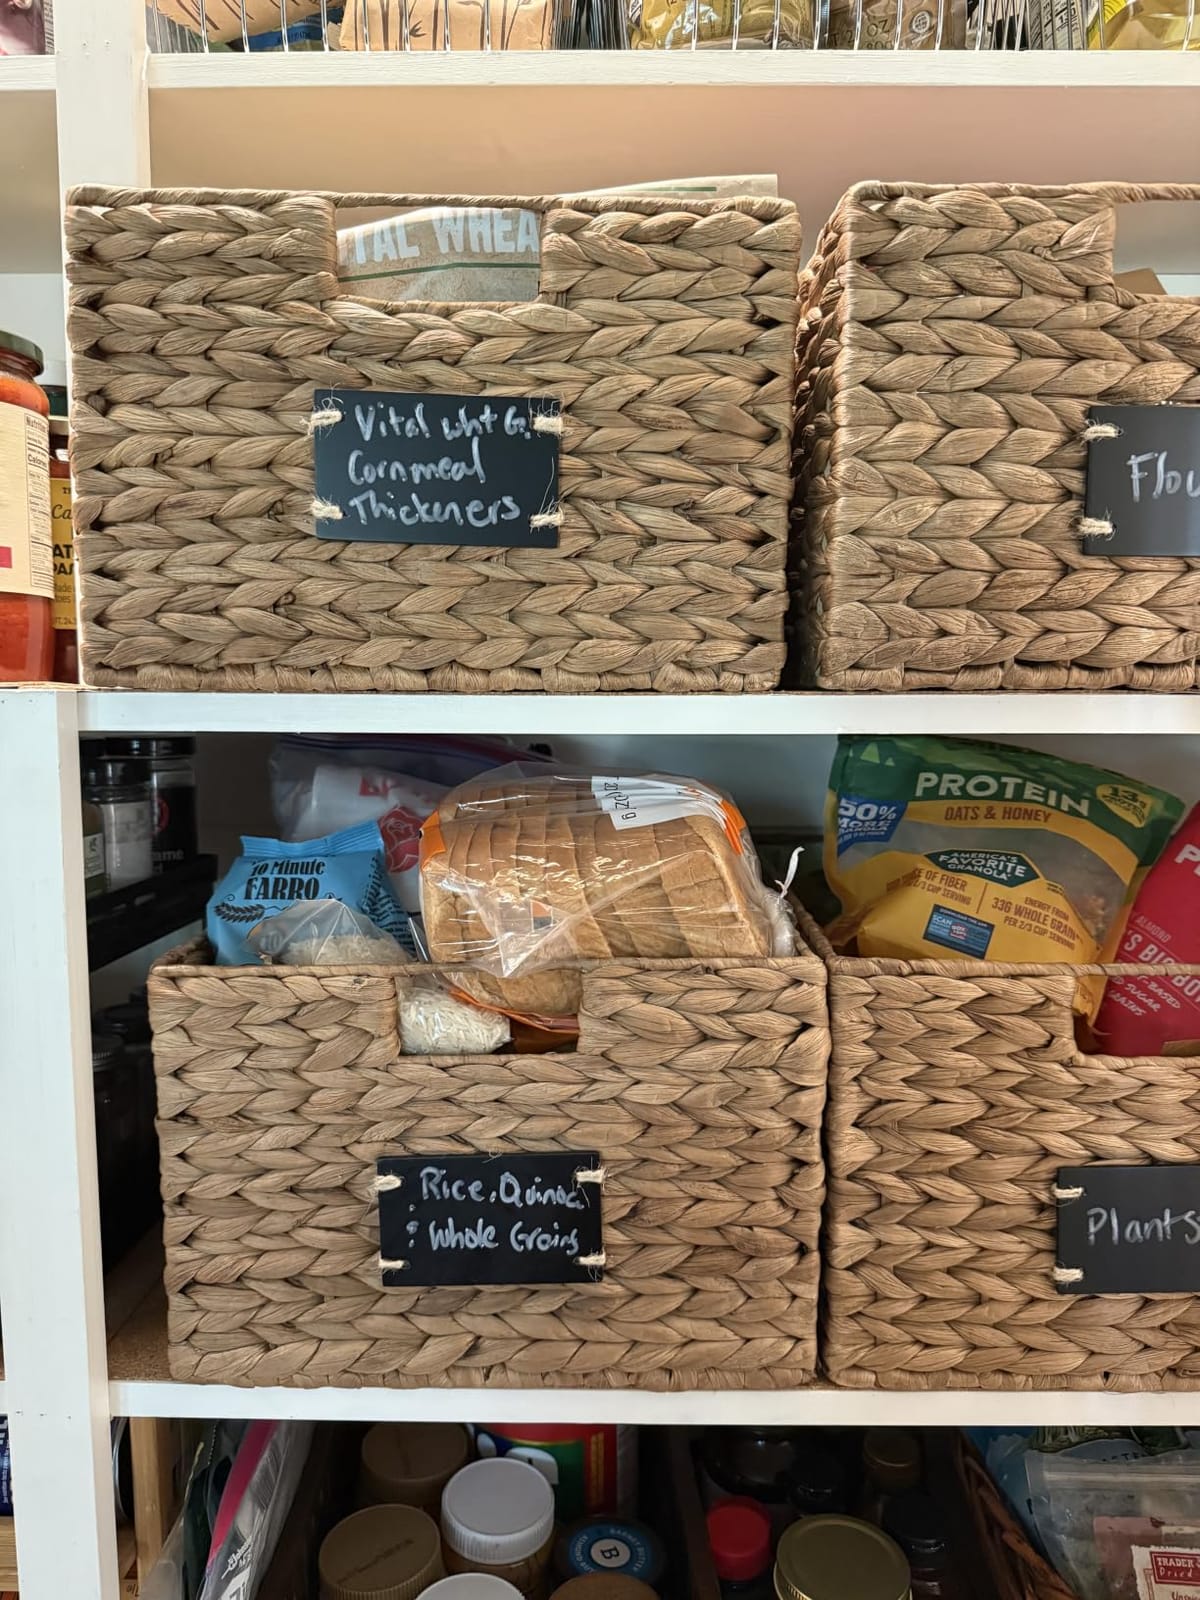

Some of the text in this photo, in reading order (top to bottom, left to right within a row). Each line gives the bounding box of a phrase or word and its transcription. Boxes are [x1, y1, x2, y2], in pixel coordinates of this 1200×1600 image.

[866, 19, 890, 37] OZ
[354, 402, 431, 441] Vital
[348, 436, 486, 485] Cornmeal
[349, 490, 520, 527] Thickeners
[915, 772, 1089, 817] PROTEIN
[838, 797, 897, 821] 50%
[944, 806, 1051, 823] OATS & HONEY
[270, 858, 326, 875] Minute
[939, 855, 1027, 877] FAVORITE
[951, 852, 1018, 864] AMERICA'S
[926, 870, 940, 881] OF
[940, 873, 968, 892] FIBER
[947, 863, 1010, 881] GRANOLA
[244, 876, 320, 900] FARRO
[1014, 904, 1049, 926] WHOLE
[1125, 983, 1161, 1012] SUGAR
[428, 1217, 499, 1251] Whole
[600, 1545, 619, 1559] B
[1156, 1557, 1194, 1568] TRADER
